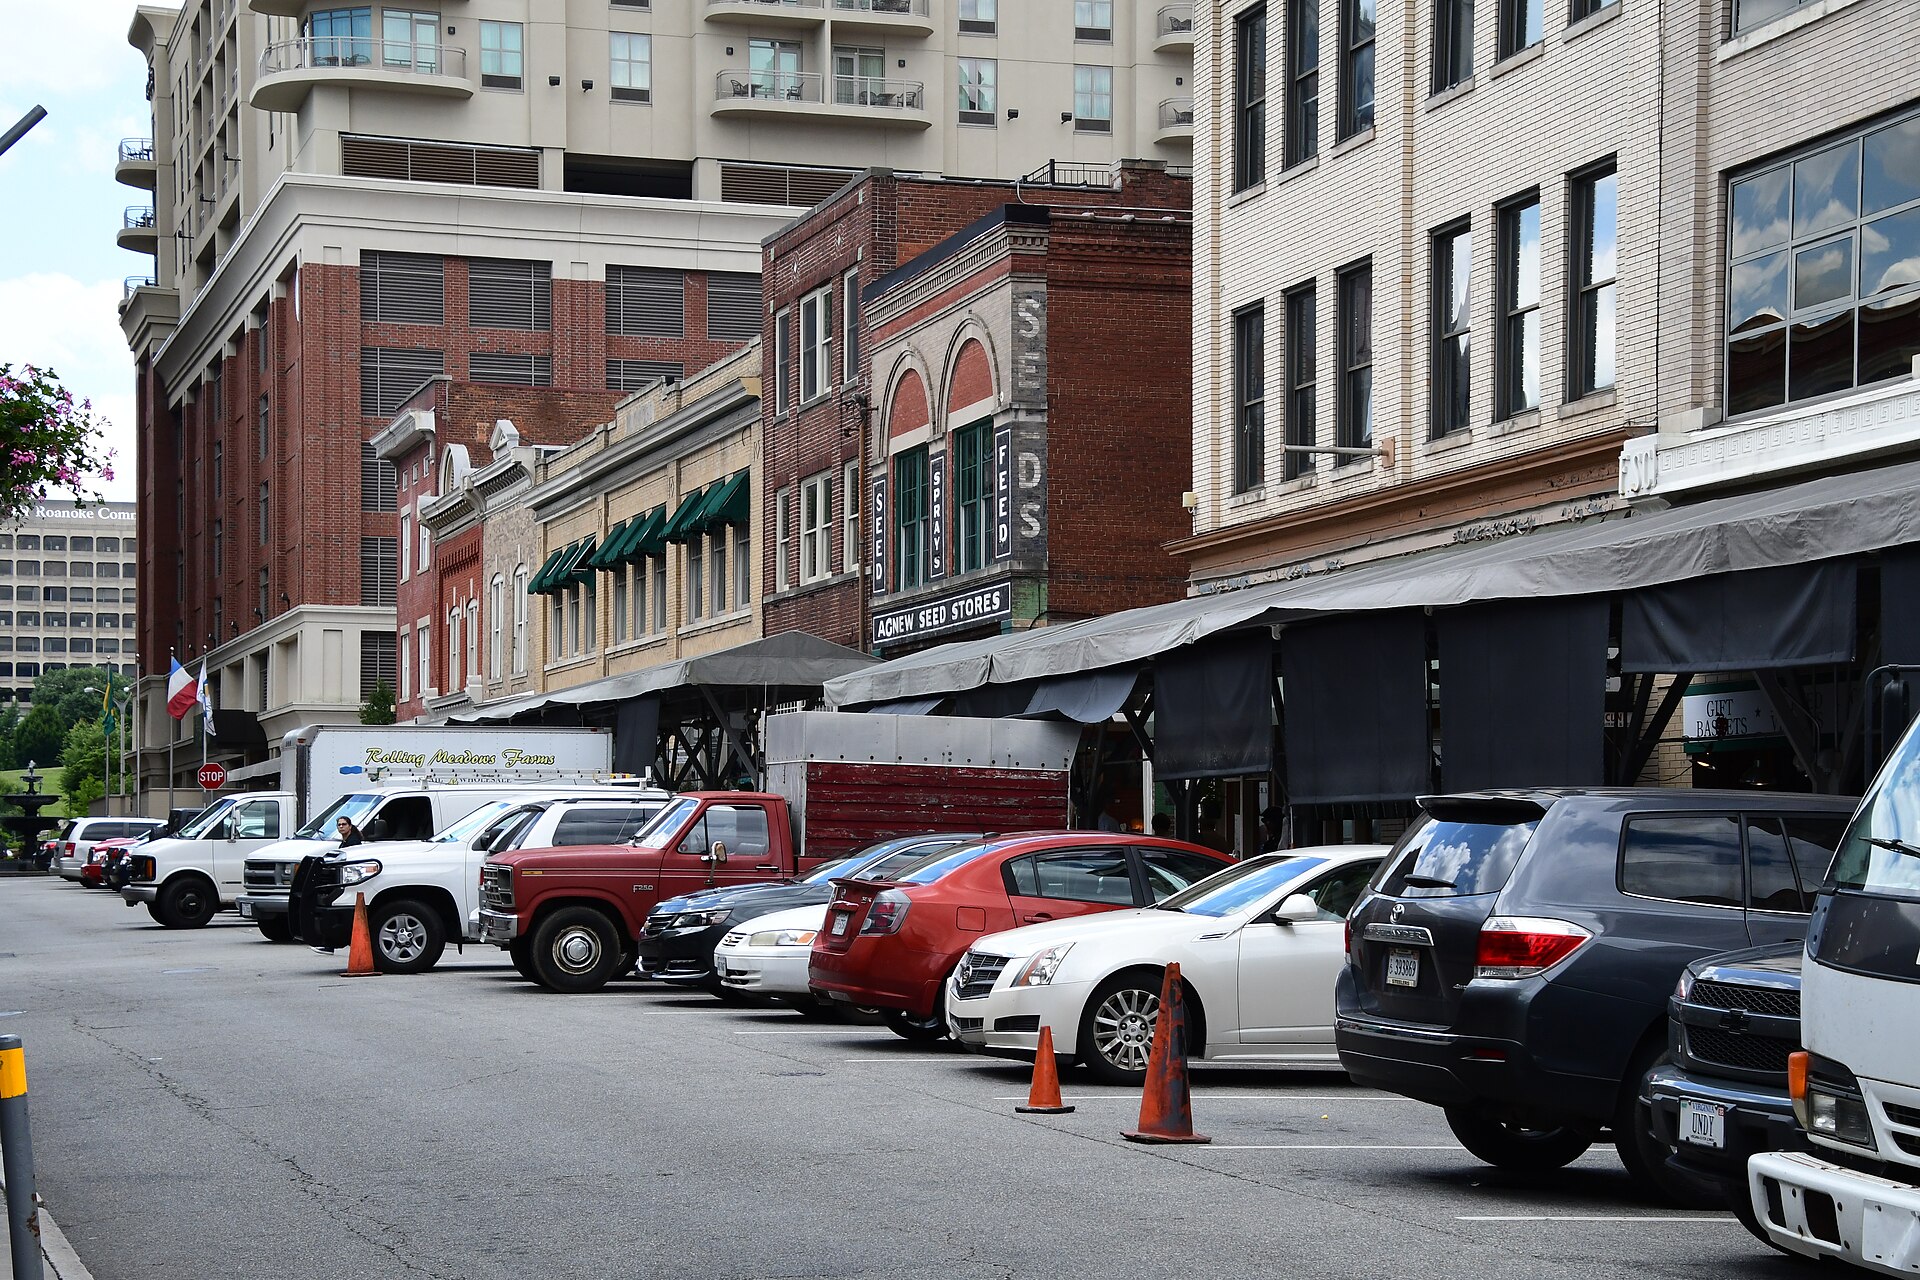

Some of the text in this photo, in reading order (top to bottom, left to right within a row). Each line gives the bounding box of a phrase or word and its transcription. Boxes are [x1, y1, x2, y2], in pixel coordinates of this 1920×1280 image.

[999, 444, 1008, 543] FEED
[36, 505, 94, 519] Roanoke
[933, 471, 941, 569] SPRAYS
[877, 591, 1000, 638] AGNEW SEED STORES
[1706, 698, 1734, 718] GIFT
[1696, 717, 1748, 737] BASETS
[365, 747, 556, 768] Rolling Meadows Farms
[199, 771, 224, 782] STOP
[1692, 1113, 1714, 1136] UNDY
